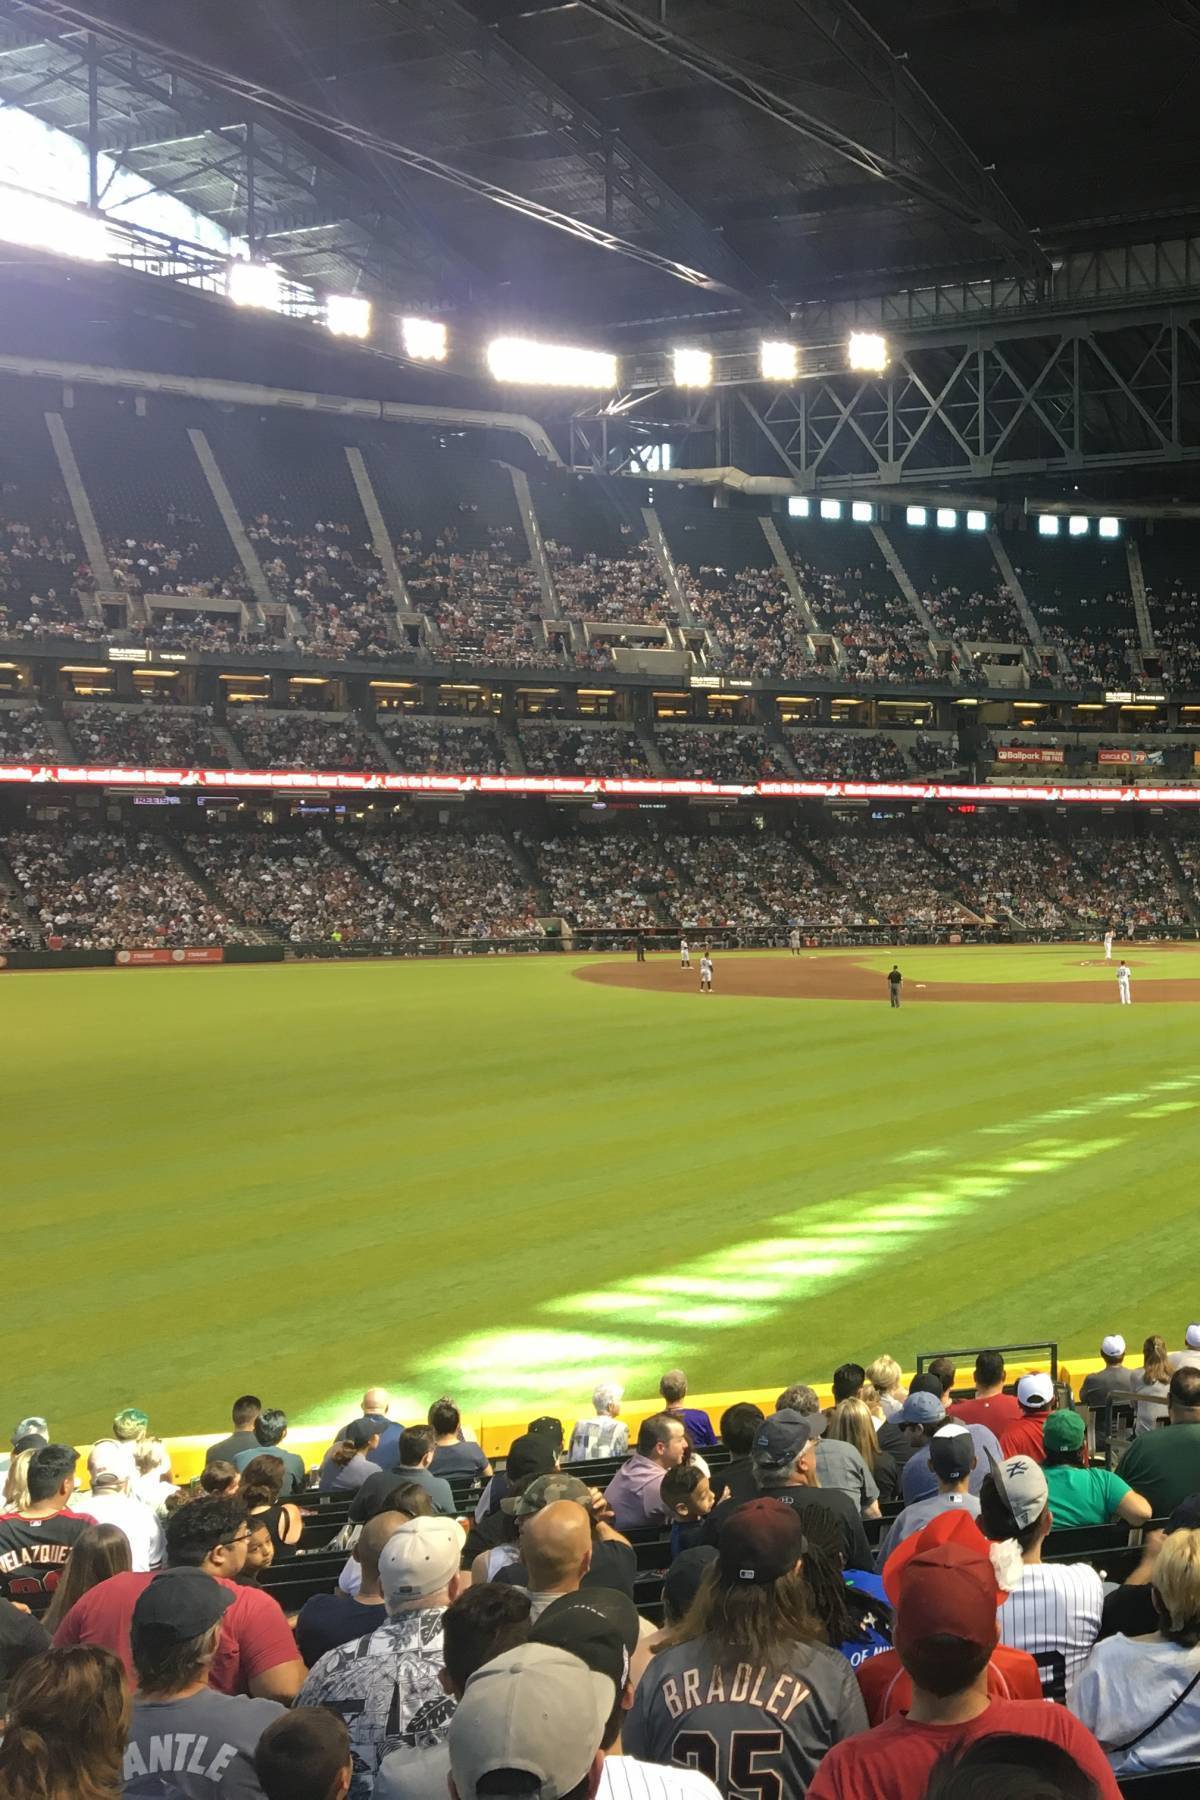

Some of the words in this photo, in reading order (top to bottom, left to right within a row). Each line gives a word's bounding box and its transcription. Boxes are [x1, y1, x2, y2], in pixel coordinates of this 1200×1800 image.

[1008, 751, 1040, 761] Ballpark
[0, 1544, 74, 1574] VELAZQUE
[850, 1649, 870, 1667] OF
[662, 1662, 811, 1720] BRADLEY
[123, 1732, 239, 1783] ANTLE
